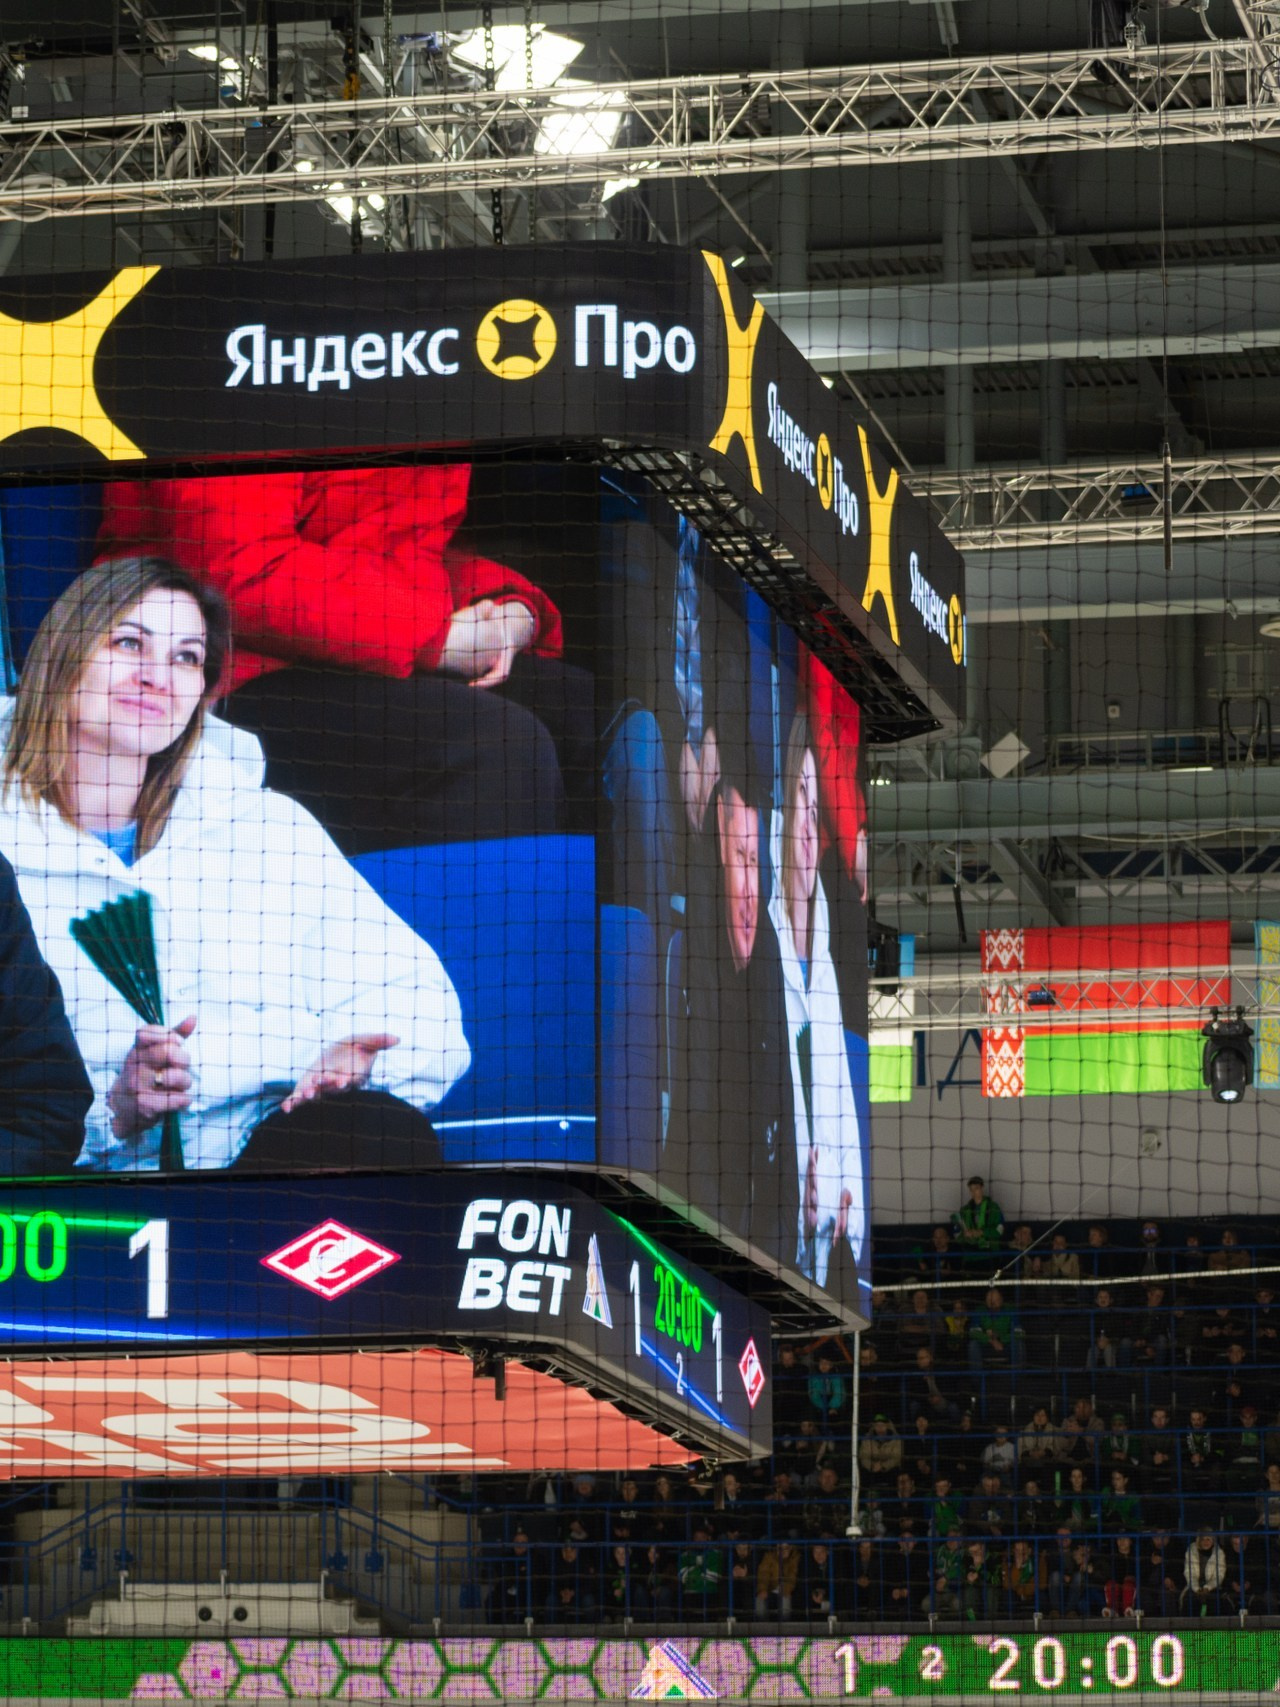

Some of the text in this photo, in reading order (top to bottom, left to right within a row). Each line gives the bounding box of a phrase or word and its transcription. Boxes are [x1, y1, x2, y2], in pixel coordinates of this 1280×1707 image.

[225, 304, 697, 392] Яндекс Про
[767, 382, 859, 536] Яндекс Про
[910, 551, 949, 645] Яндекс
[129, 1219, 169, 1319] 1
[457, 1199, 572, 1257] FON
[457, 1257, 572, 1316] BET
[630, 1260, 641, 1357] 1
[654, 1263, 702, 1353] 20:00
[676, 1351, 684, 1396] 2
[712, 1311, 723, 1402] 1
[834, 1643, 856, 1693] 1
[920, 1646, 945, 1681] 2
[988, 1634, 1184, 1690] 20:00
